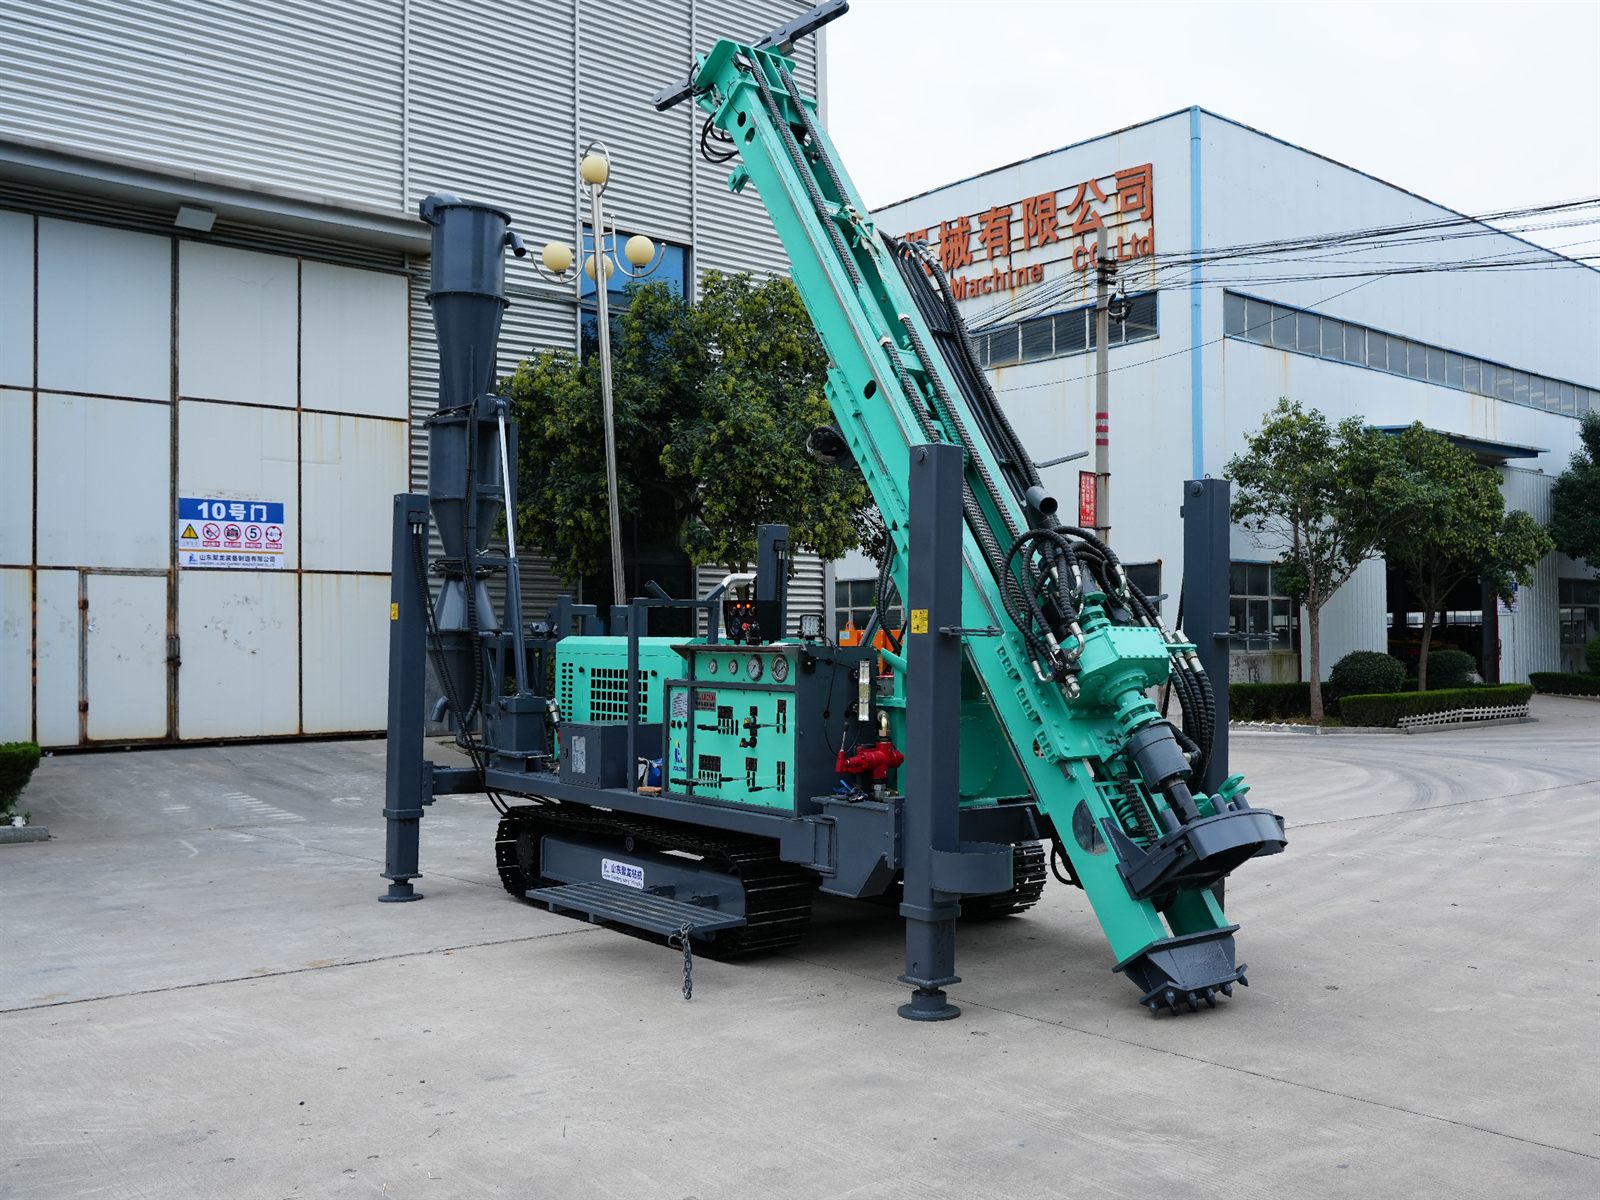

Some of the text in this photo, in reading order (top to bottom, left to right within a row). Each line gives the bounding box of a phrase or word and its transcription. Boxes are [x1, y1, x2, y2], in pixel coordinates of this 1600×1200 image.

[950, 263, 1043, 301] Machine
[1117, 228, 1153, 263] Ltd
[197, 502, 267, 521] 10号门
[250, 528, 257, 539] 5
